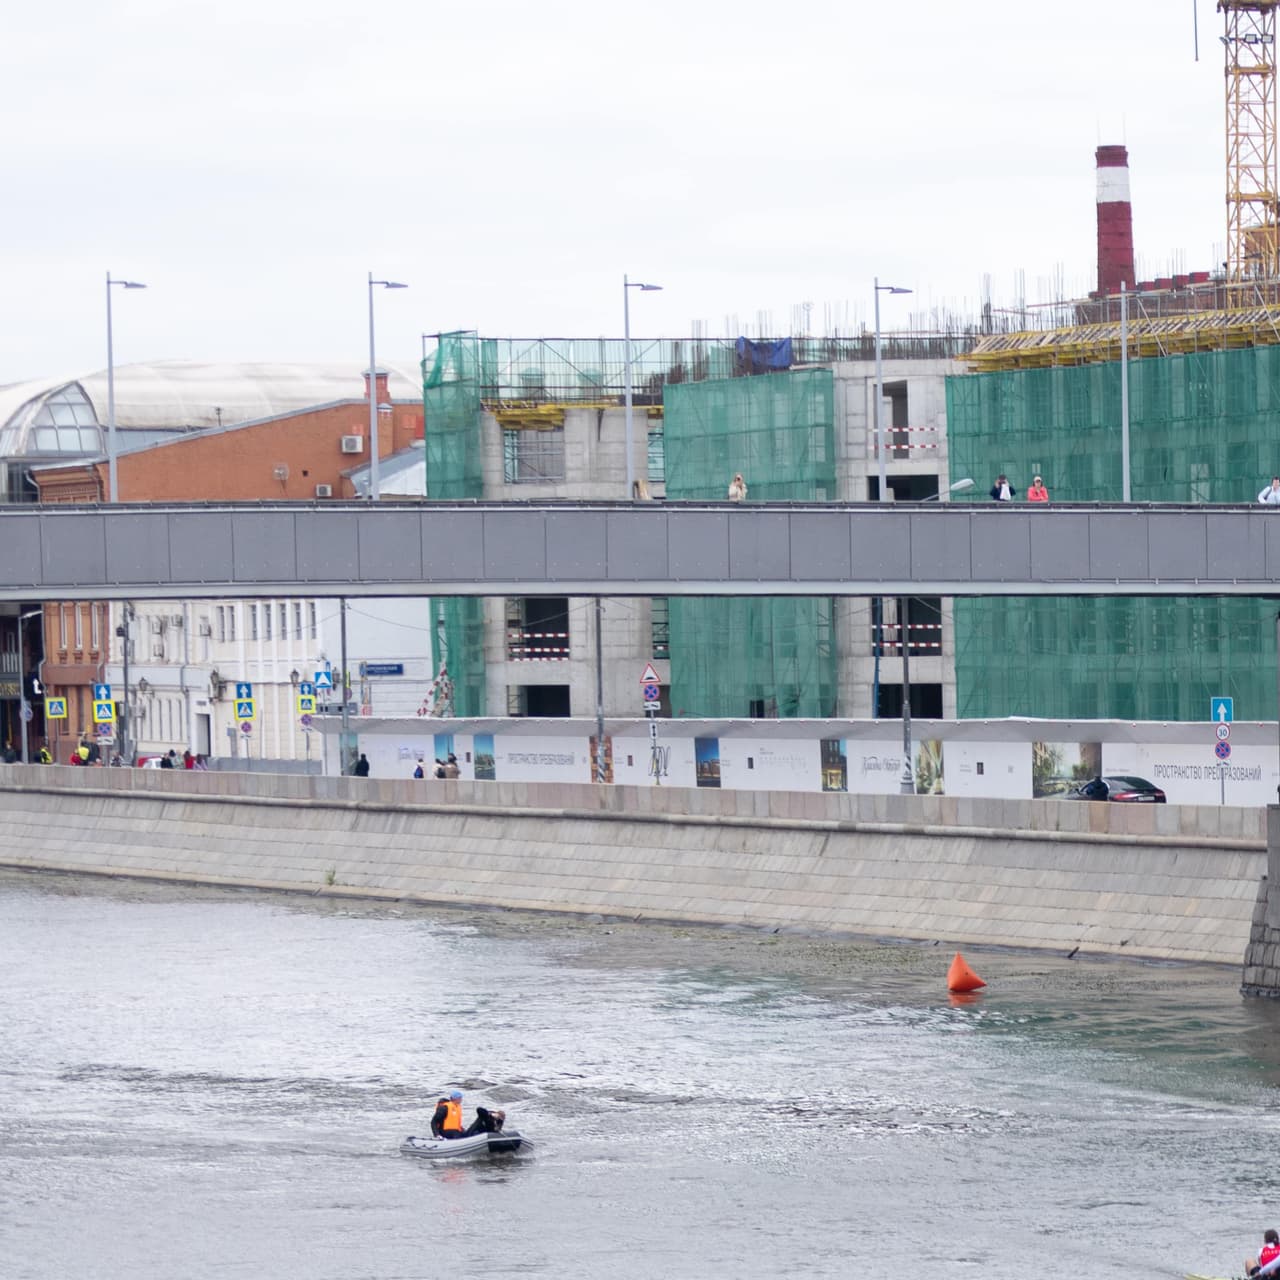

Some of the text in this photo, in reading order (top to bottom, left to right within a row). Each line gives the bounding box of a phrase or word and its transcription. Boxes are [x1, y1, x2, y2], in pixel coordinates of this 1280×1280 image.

[1218, 729, 1228, 737] 30
[1153, 764, 1262, 781] ПРОСТРАНСТВО ПРЕОРАЗОВАНИЙ
